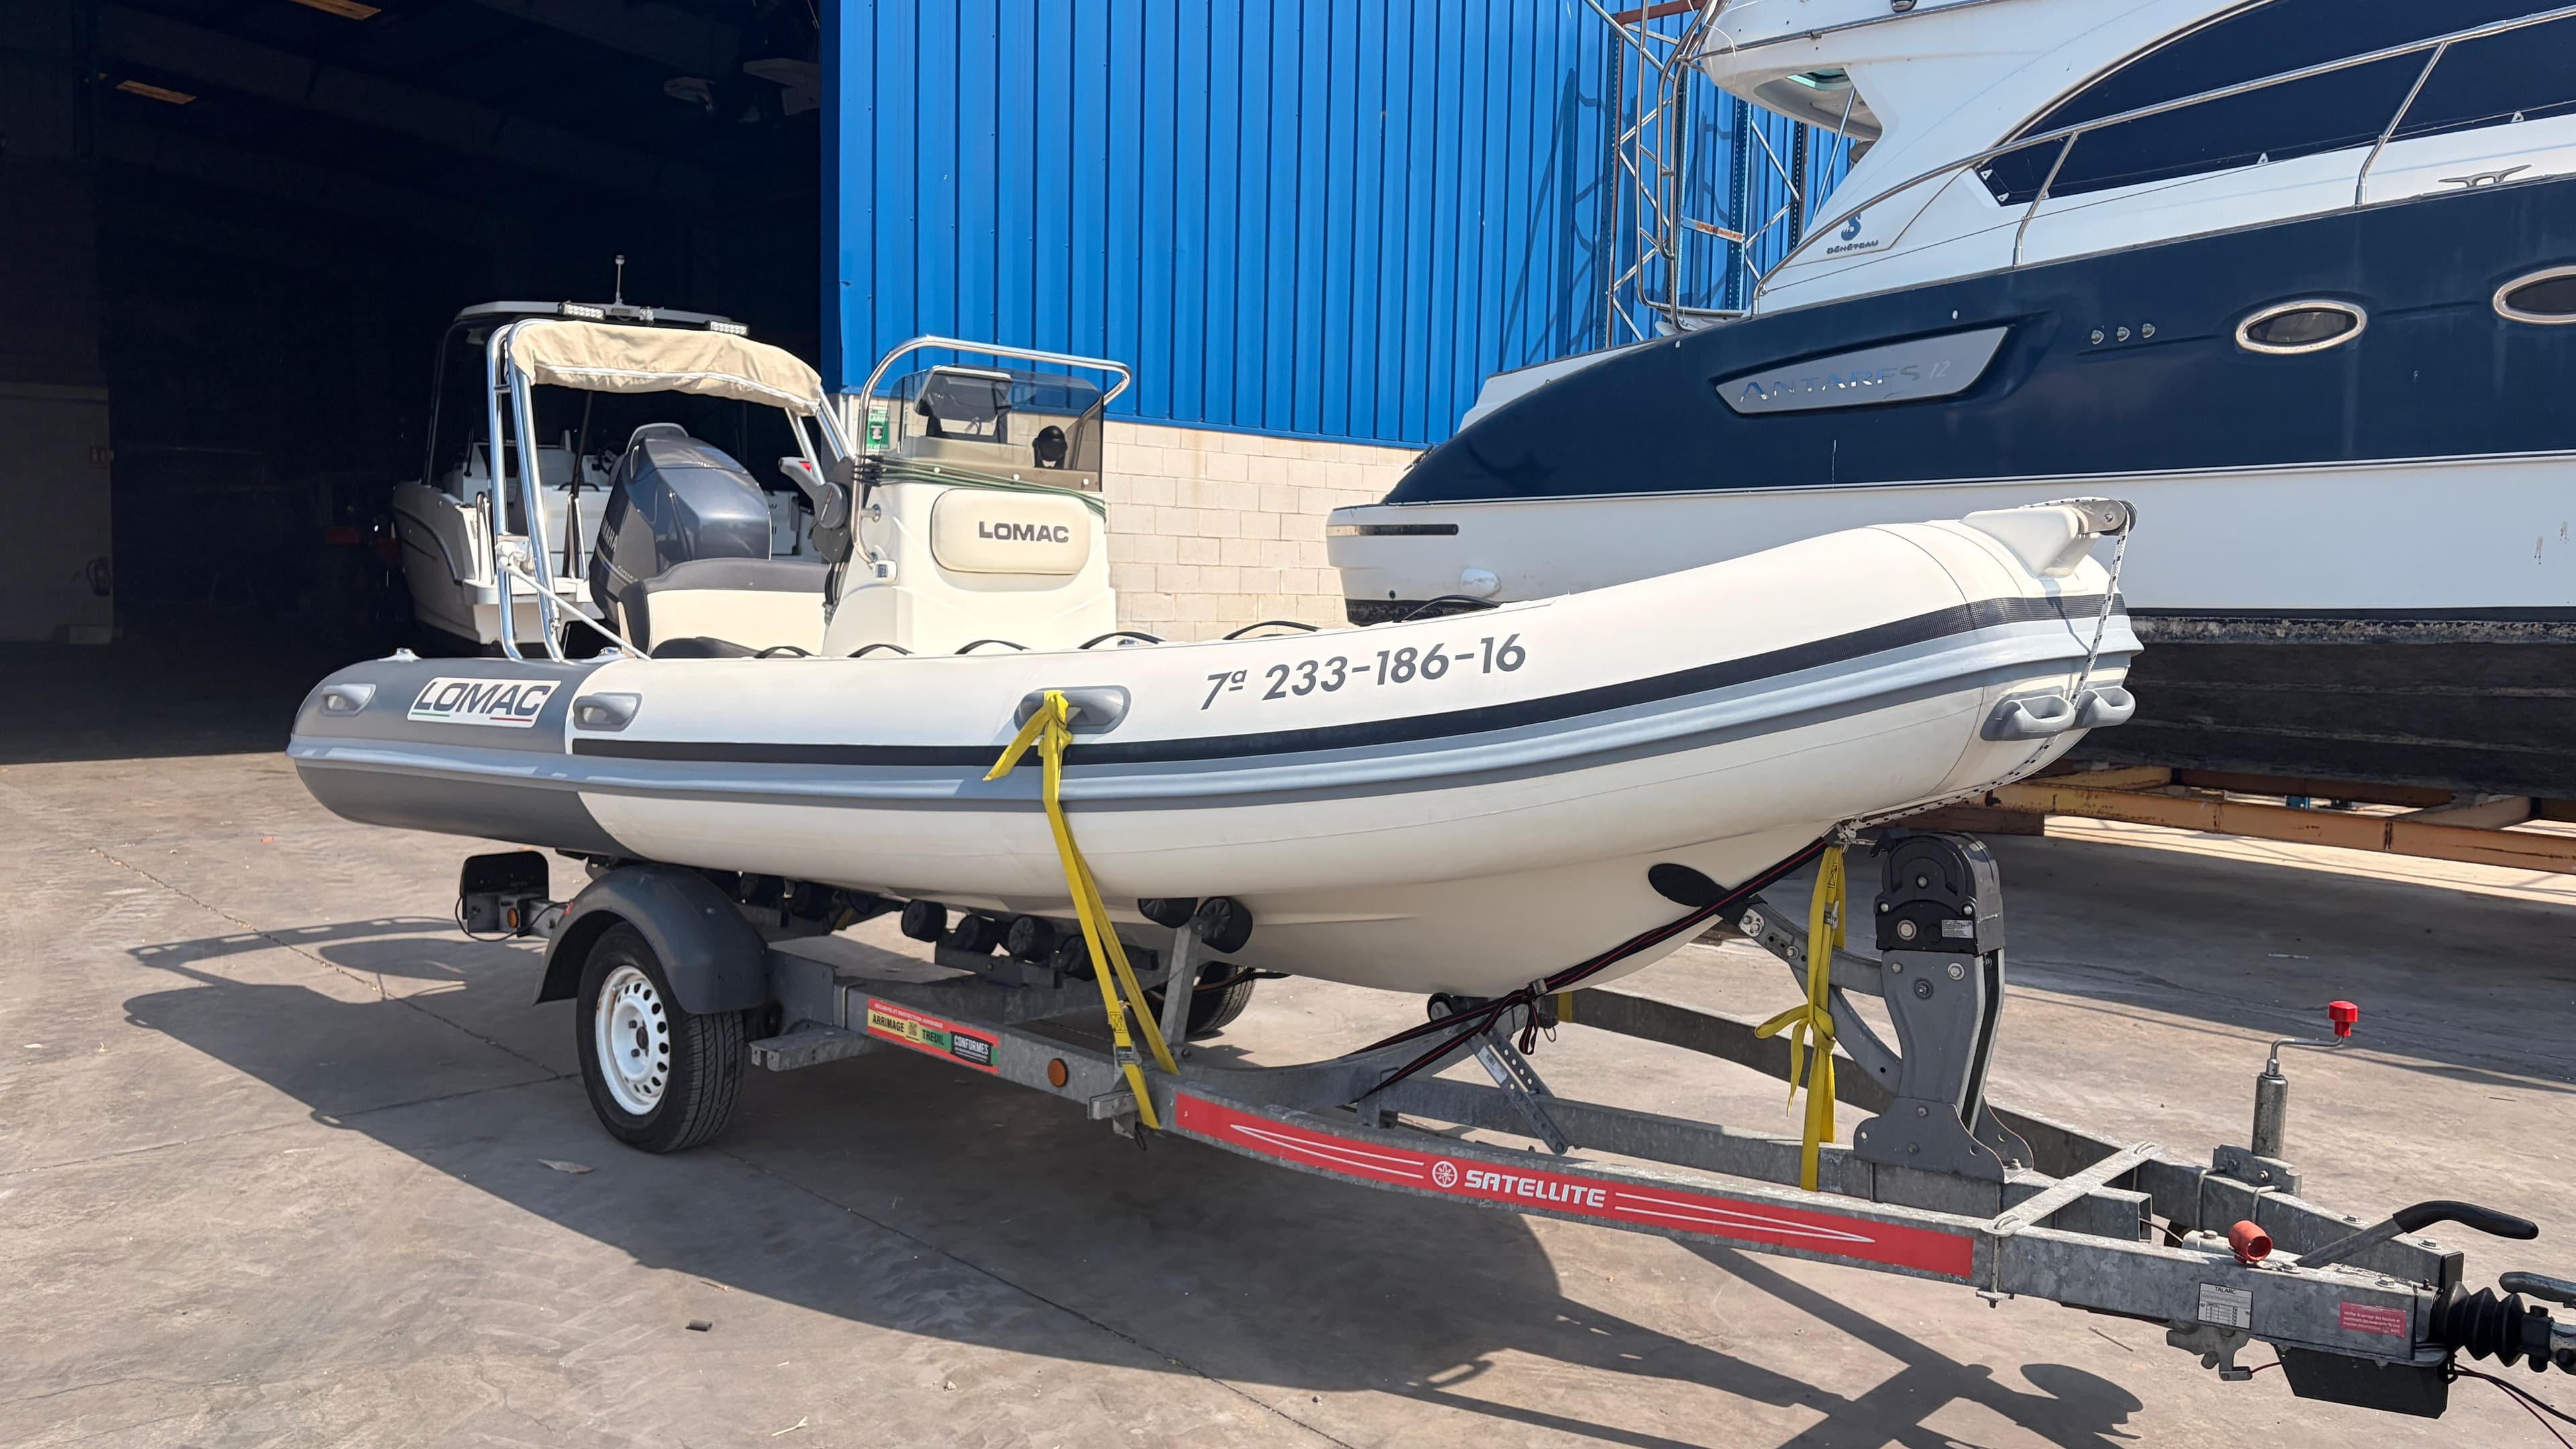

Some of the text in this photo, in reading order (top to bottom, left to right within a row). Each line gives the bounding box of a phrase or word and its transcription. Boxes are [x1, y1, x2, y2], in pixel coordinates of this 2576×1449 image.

[979, 521, 1069, 543] LOMAC
[1261, 633, 1526, 700] 233-186-16
[414, 681, 552, 716] LOMAC
[873, 1014, 904, 1032] ARRIMAGE
[922, 1029, 945, 1046] TREUIL
[954, 1035, 989, 1055] CONFORMES
[1464, 1169, 1607, 1208] SATELLITE
